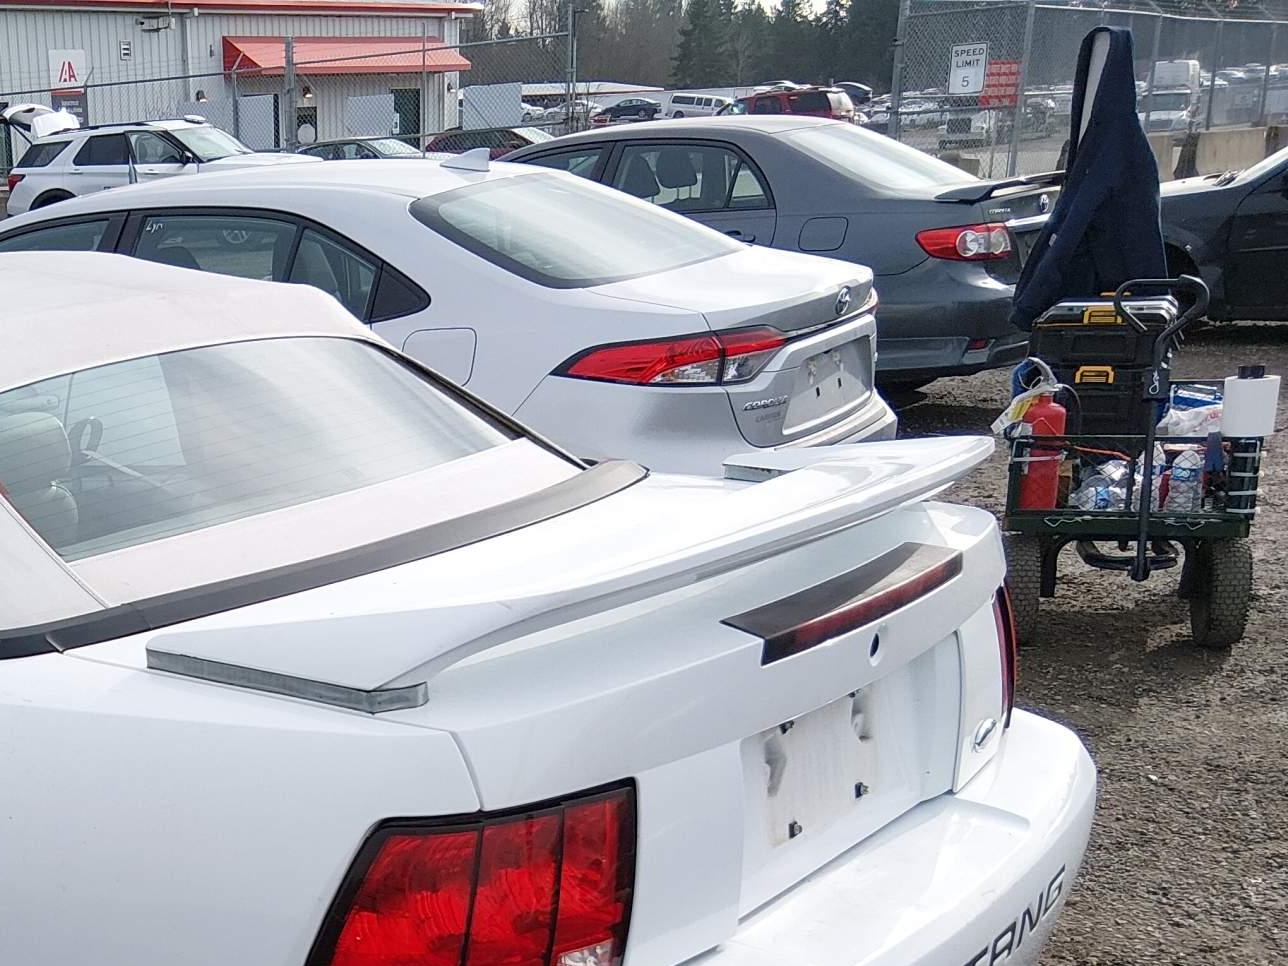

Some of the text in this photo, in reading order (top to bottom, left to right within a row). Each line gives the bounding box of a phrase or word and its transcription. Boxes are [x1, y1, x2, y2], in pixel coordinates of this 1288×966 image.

[954, 48, 985, 57] SPEED
[956, 59, 980, 68] LIMIT
[961, 76, 970, 87] 5
